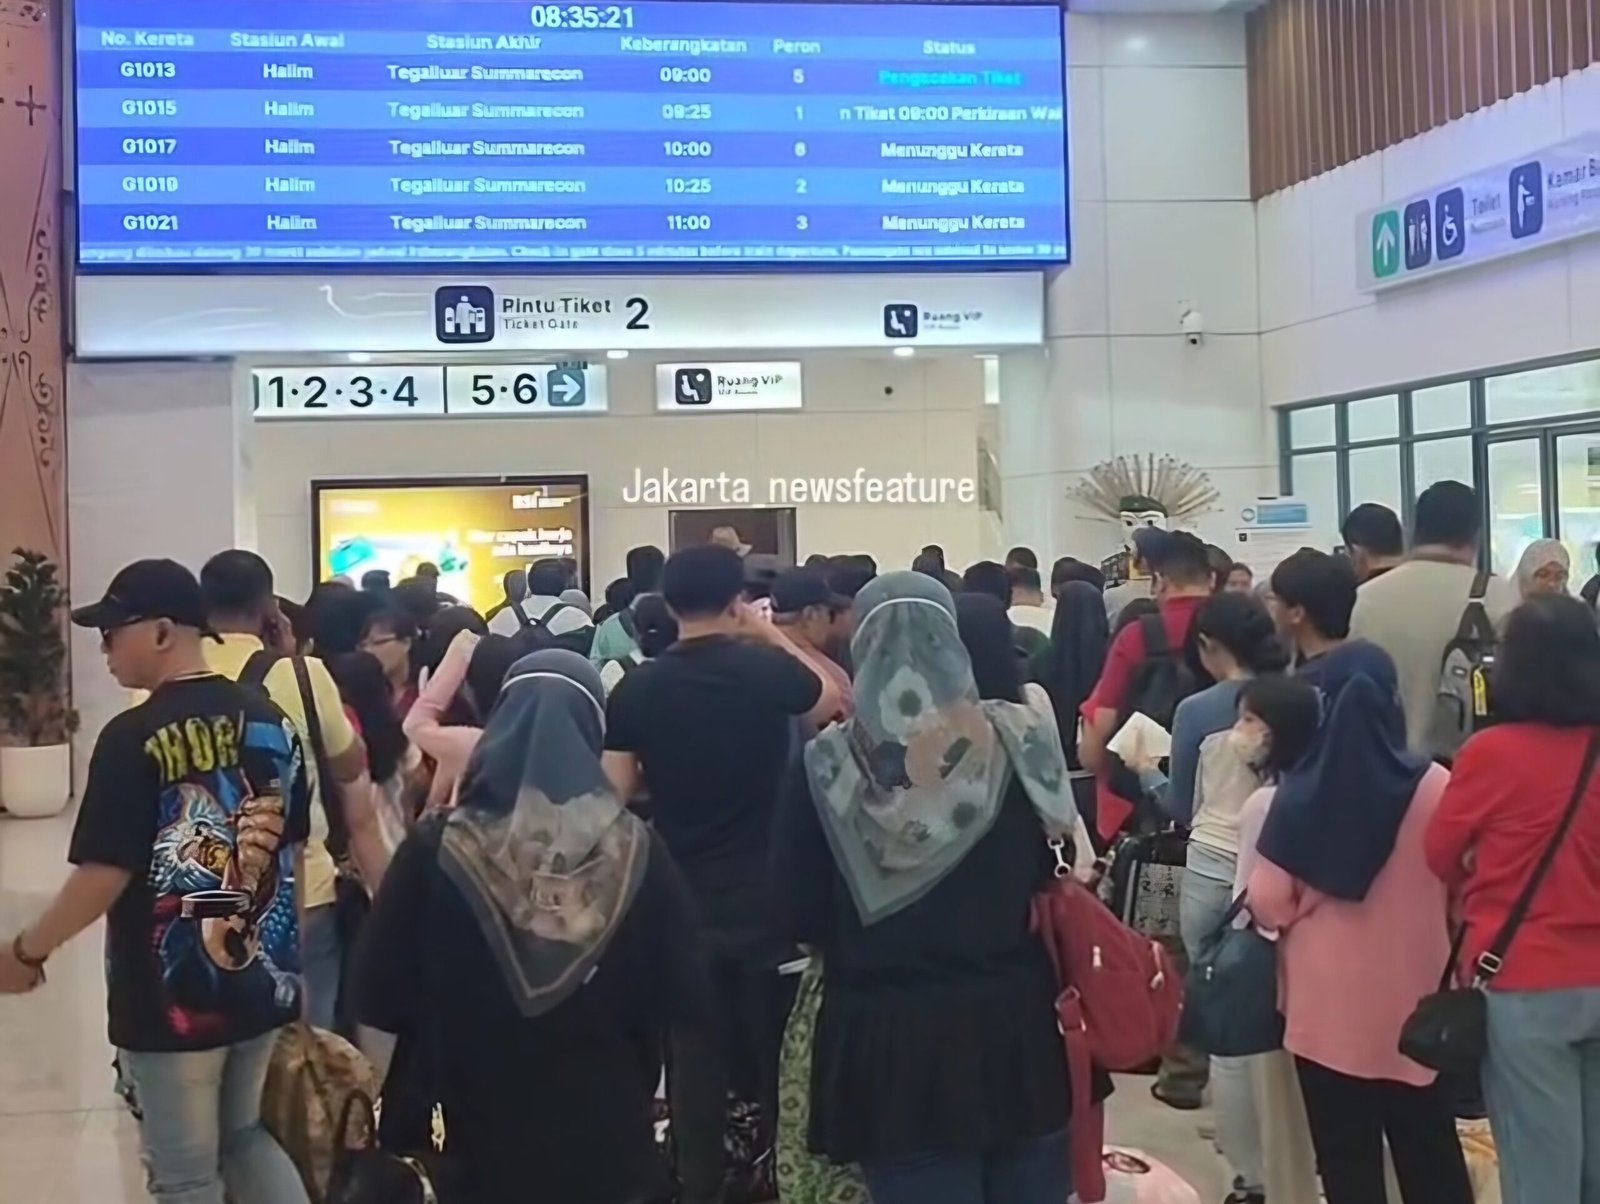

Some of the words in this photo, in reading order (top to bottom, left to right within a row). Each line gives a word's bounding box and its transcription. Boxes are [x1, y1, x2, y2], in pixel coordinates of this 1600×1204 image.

[531, 5, 634, 28] 08:35:21
[101, 31, 131, 47] No.
[135, 32, 194, 47] Kereta
[230, 32, 297, 48] Stasiun
[300, 33, 345, 48] Awal
[426, 33, 492, 50] Stasiun
[496, 34, 542, 50] Akhir
[620, 36, 747, 56] Keberangkatan
[773, 38, 821, 53] Peron
[923, 39, 976, 56] Status
[120, 61, 176, 78] G1013
[263, 63, 314, 79] Halim
[387, 64, 469, 82] Tegalluar
[470, 65, 584, 81] Summarecon
[659, 66, 711, 83] 09:00
[792, 68, 805, 84] 5
[121, 99, 177, 116] G1015
[264, 101, 315, 117] Halim
[388, 102, 470, 121] Tegalluar
[472, 103, 585, 119] Summarecon
[662, 104, 712, 120] 09:25
[795, 105, 804, 121] 1
[854, 105, 896, 121] Tiket
[951, 106, 1027, 121] Perkiraan
[122, 138, 178, 154] G1017
[264, 139, 316, 155] Halim
[389, 140, 471, 159] Tegalluar
[472, 141, 586, 157] Summarecon
[664, 141, 712, 156] 10:00
[881, 143, 968, 160] Menunggu
[969, 144, 1024, 158] Kereta
[265, 178, 316, 194] Halim
[390, 178, 471, 197] Tegalluar
[473, 179, 587, 195] Summarecon
[665, 178, 712, 194] 10:25
[795, 178, 808, 194] 2
[881, 178, 969, 197] Menunggu
[970, 180, 1025, 194] Kereta
[123, 215, 179, 231] G1021
[266, 215, 317, 231] Halim
[390, 216, 471, 234] Tegalluar
[474, 216, 588, 232] Summarecon
[666, 215, 712, 230] 11:00
[796, 215, 809, 230] 3
[882, 215, 969, 233] Menunggu
[971, 216, 1026, 230] Kereta
[502, 298, 555, 314] Pintu
[559, 297, 612, 314] Tiket
[625, 297, 651, 330] 2
[923, 311, 961, 323] Ruang
[504, 318, 545, 330] Ticket
[717, 375, 759, 388] Ruang
[761, 374, 784, 385] VIP
